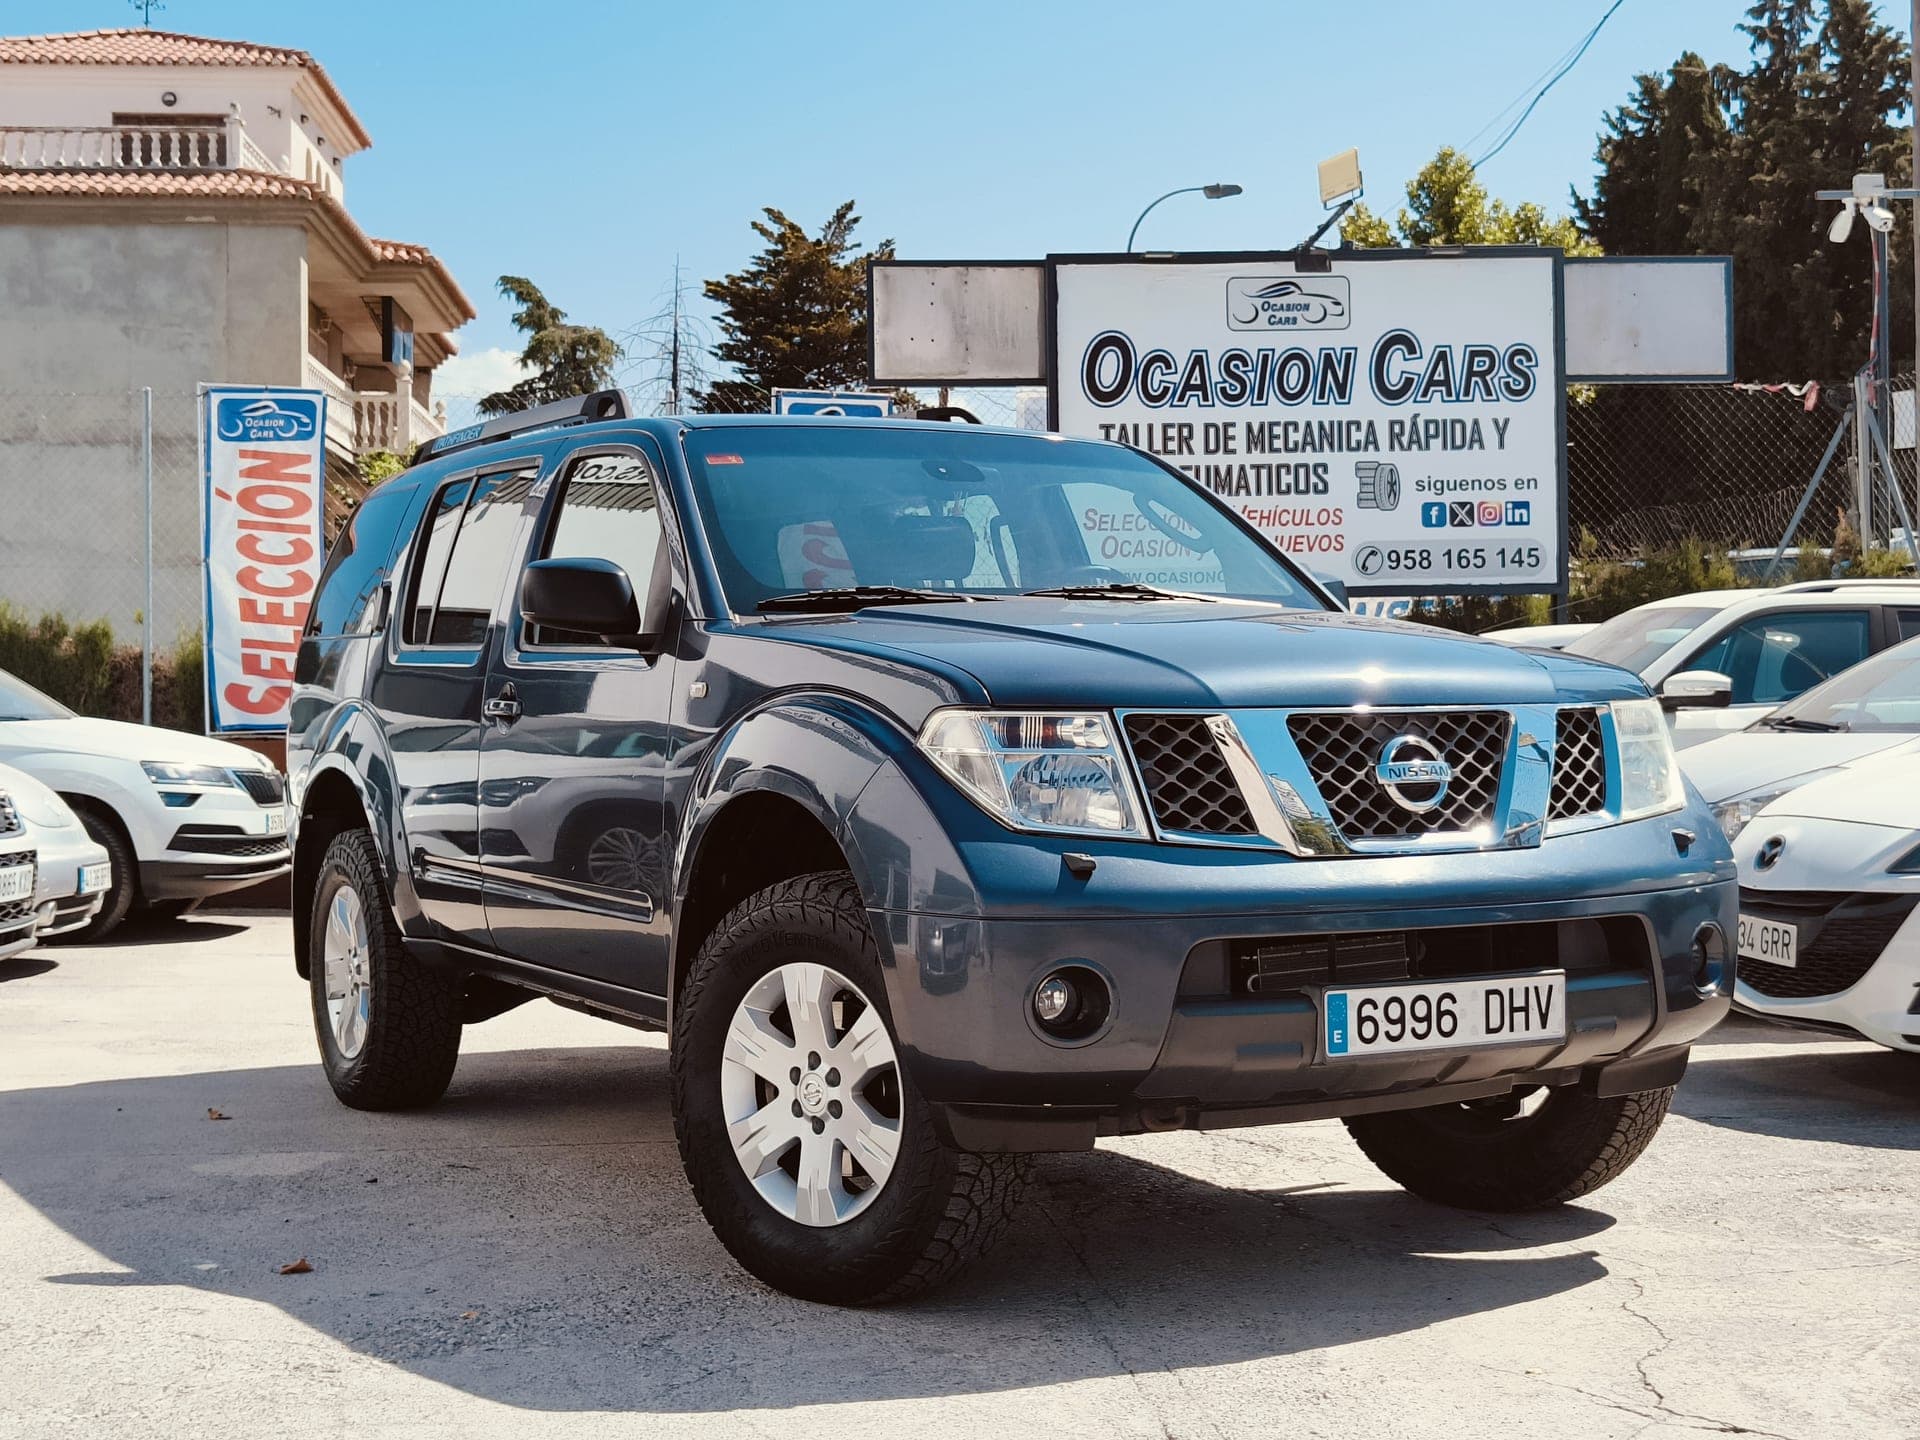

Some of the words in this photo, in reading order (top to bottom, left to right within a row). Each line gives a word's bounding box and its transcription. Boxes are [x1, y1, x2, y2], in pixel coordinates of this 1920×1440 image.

[1261, 301, 1310, 312] OCASION
[1268, 315, 1298, 326] CARS
[1081, 329, 1357, 409] OCASION
[1370, 328, 1539, 404] CARS
[245, 417, 285, 427] OCASION
[250, 429, 274, 439] CARS
[1203, 421, 1237, 456] DE
[1245, 419, 1380, 454] MECANICA
[1388, 413, 1486, 452] RÁPIDA
[1492, 417, 1511, 450] Y
[1179, 463, 1330, 497] UMATICOS
[1415, 475, 1507, 496] siguenos
[1514, 478, 1538, 490] en
[1275, 534, 1345, 553] UEVOS
[1387, 549, 1432, 571] 958
[1442, 548, 1487, 570] 165
[1496, 547, 1541, 569] 145
[1388, 765, 1449, 779] NISSAN
[1760, 926, 1792, 960] GRR
[1333, 1030, 1343, 1043] E
[1357, 992, 1458, 1044] 6996
[1485, 984, 1554, 1034] DHV
